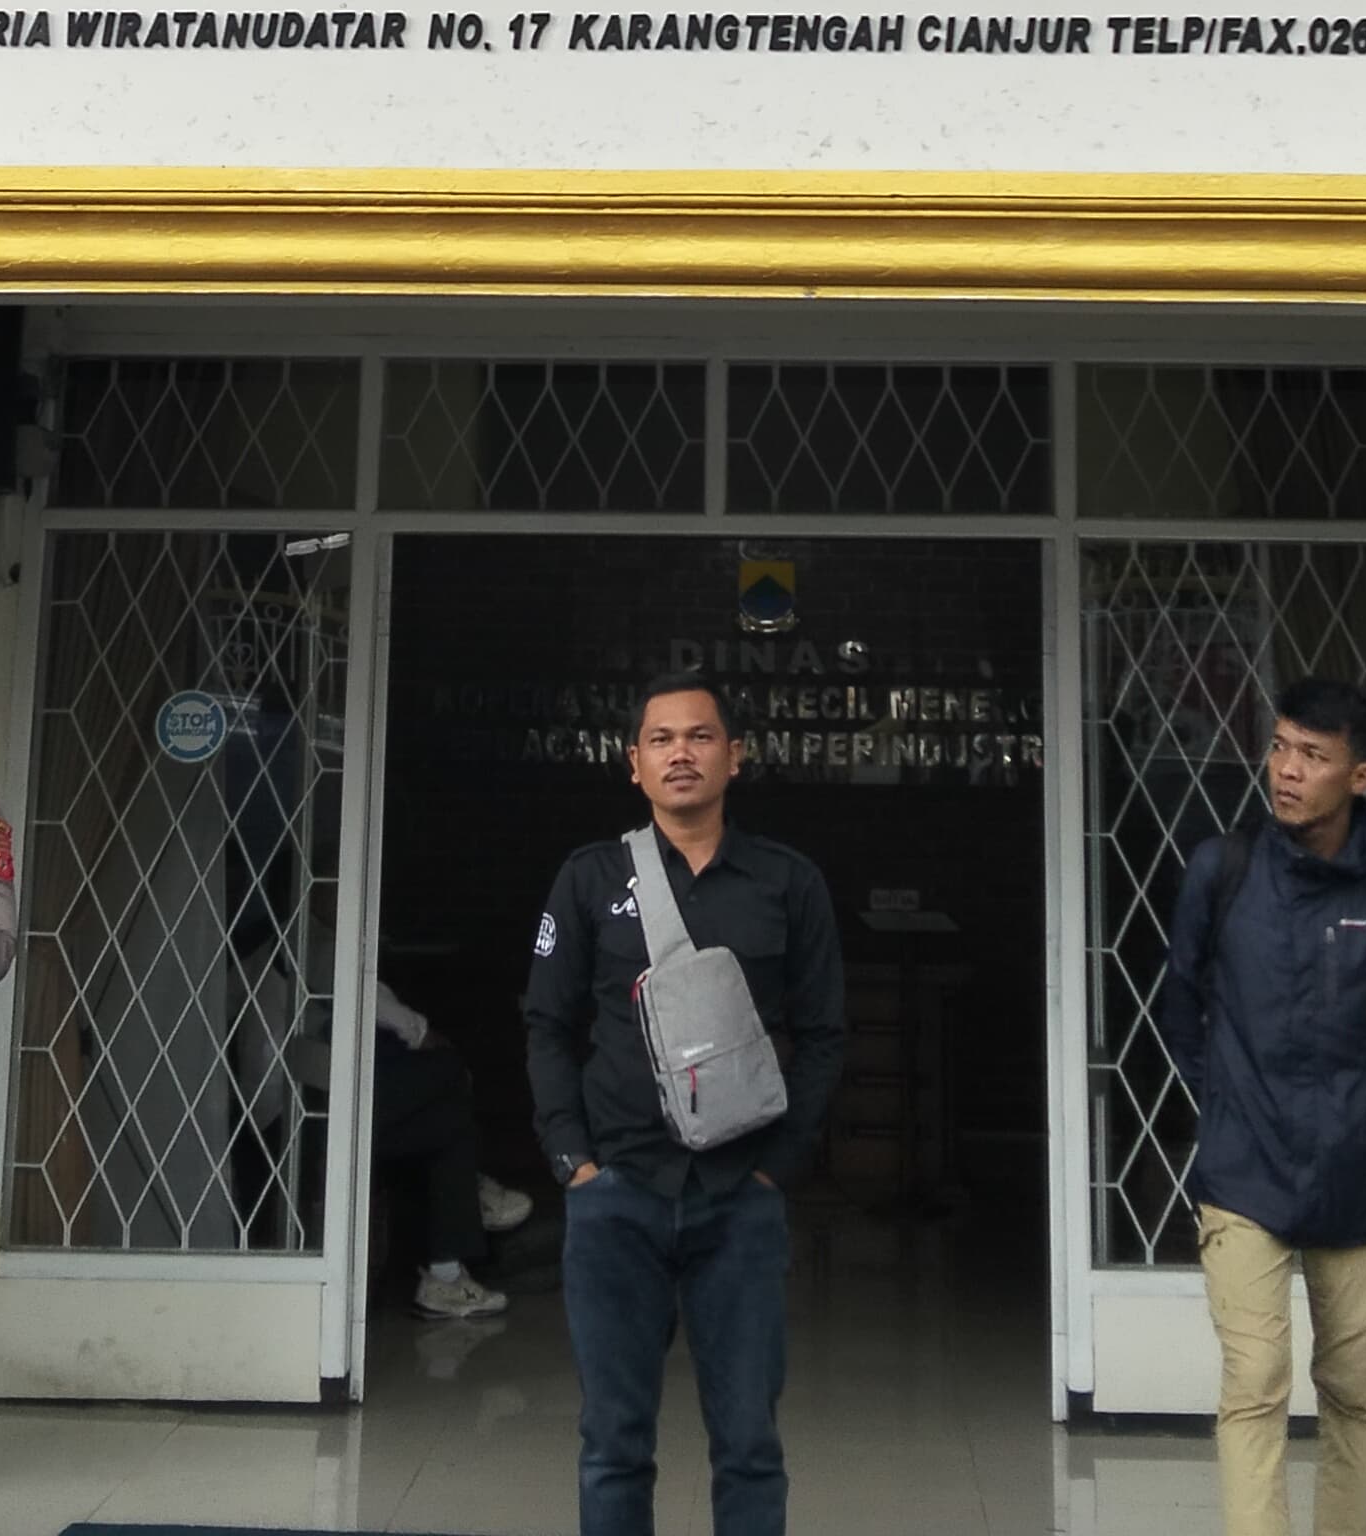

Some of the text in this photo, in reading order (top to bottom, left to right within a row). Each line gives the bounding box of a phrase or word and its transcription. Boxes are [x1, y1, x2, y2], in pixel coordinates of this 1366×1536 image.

[68, 12, 406, 49] WIRATANUDATAR
[429, 14, 493, 51] NO.
[510, 14, 551, 50] 17
[569, 14, 903, 52] KARANGTENGAH
[919, 16, 1091, 53] CIANJUR
[669, 639, 871, 675] DINAS
[170, 713, 212, 727] STOP
[768, 685, 876, 720] KECIL
